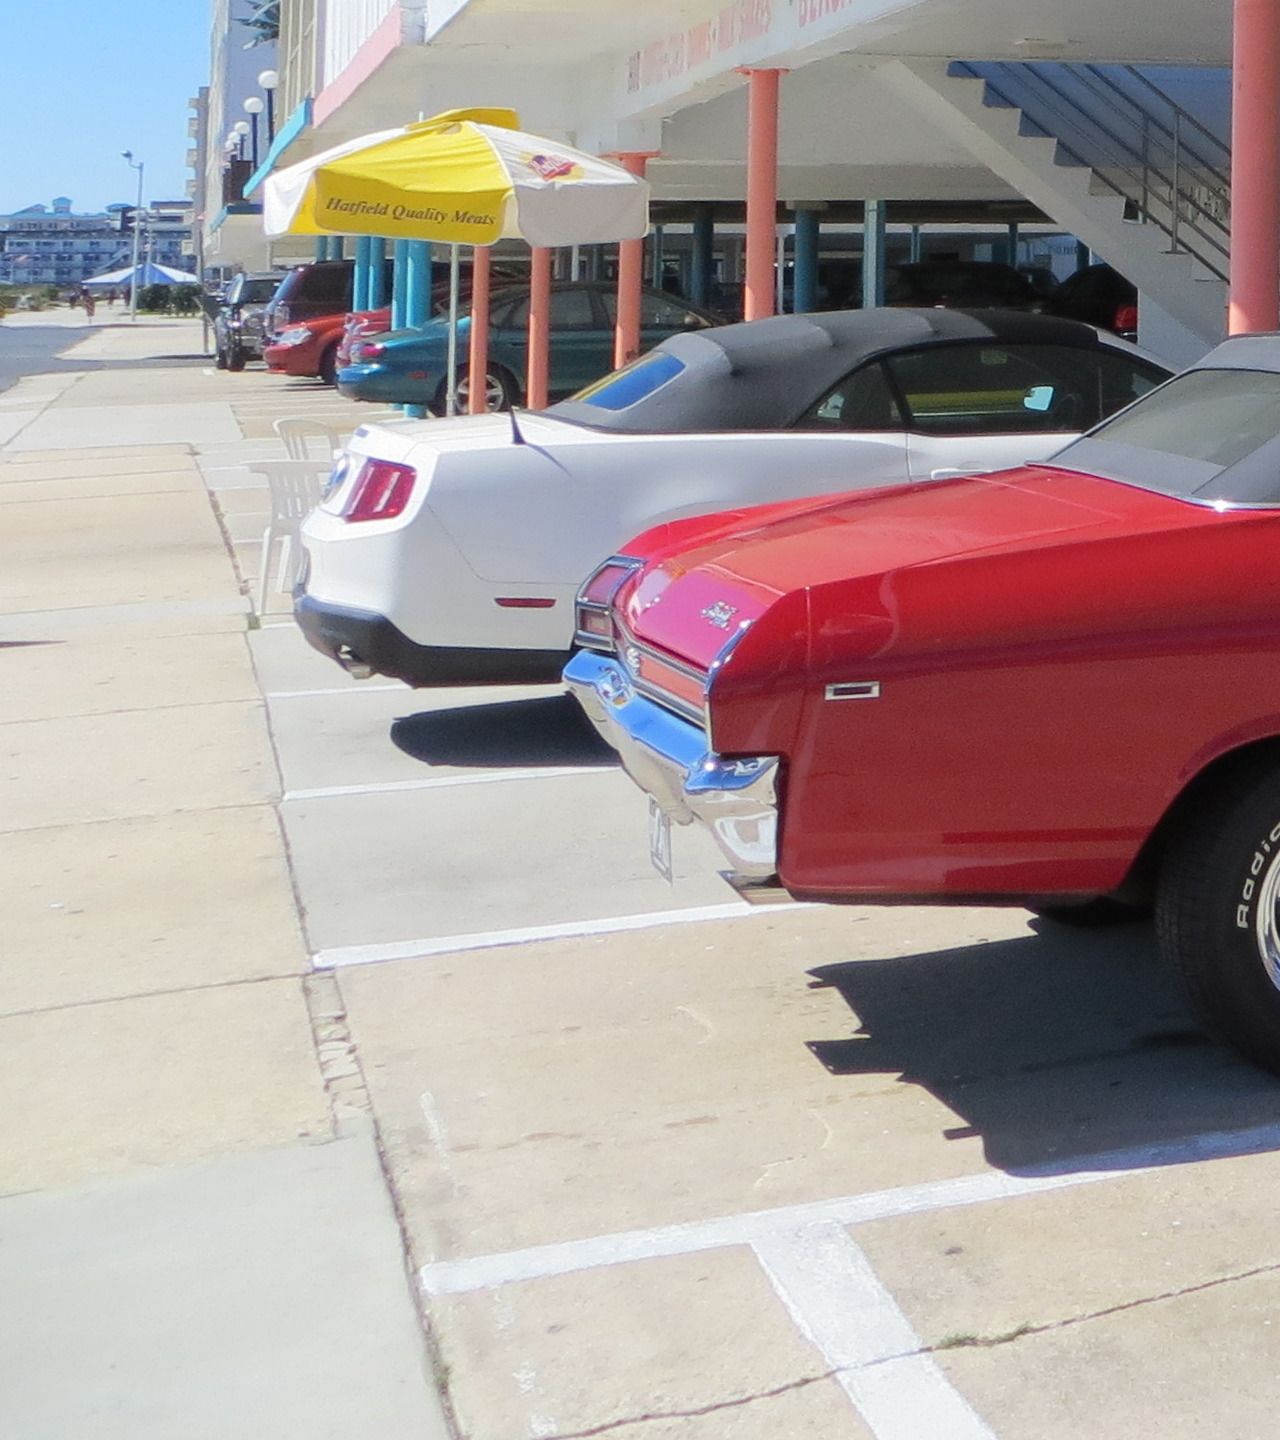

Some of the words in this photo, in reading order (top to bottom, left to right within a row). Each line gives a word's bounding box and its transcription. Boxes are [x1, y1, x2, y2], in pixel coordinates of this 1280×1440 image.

[325, 197, 389, 216] Hatfield
[392, 205, 448, 225] Quality
[450, 210, 497, 226] Meats
